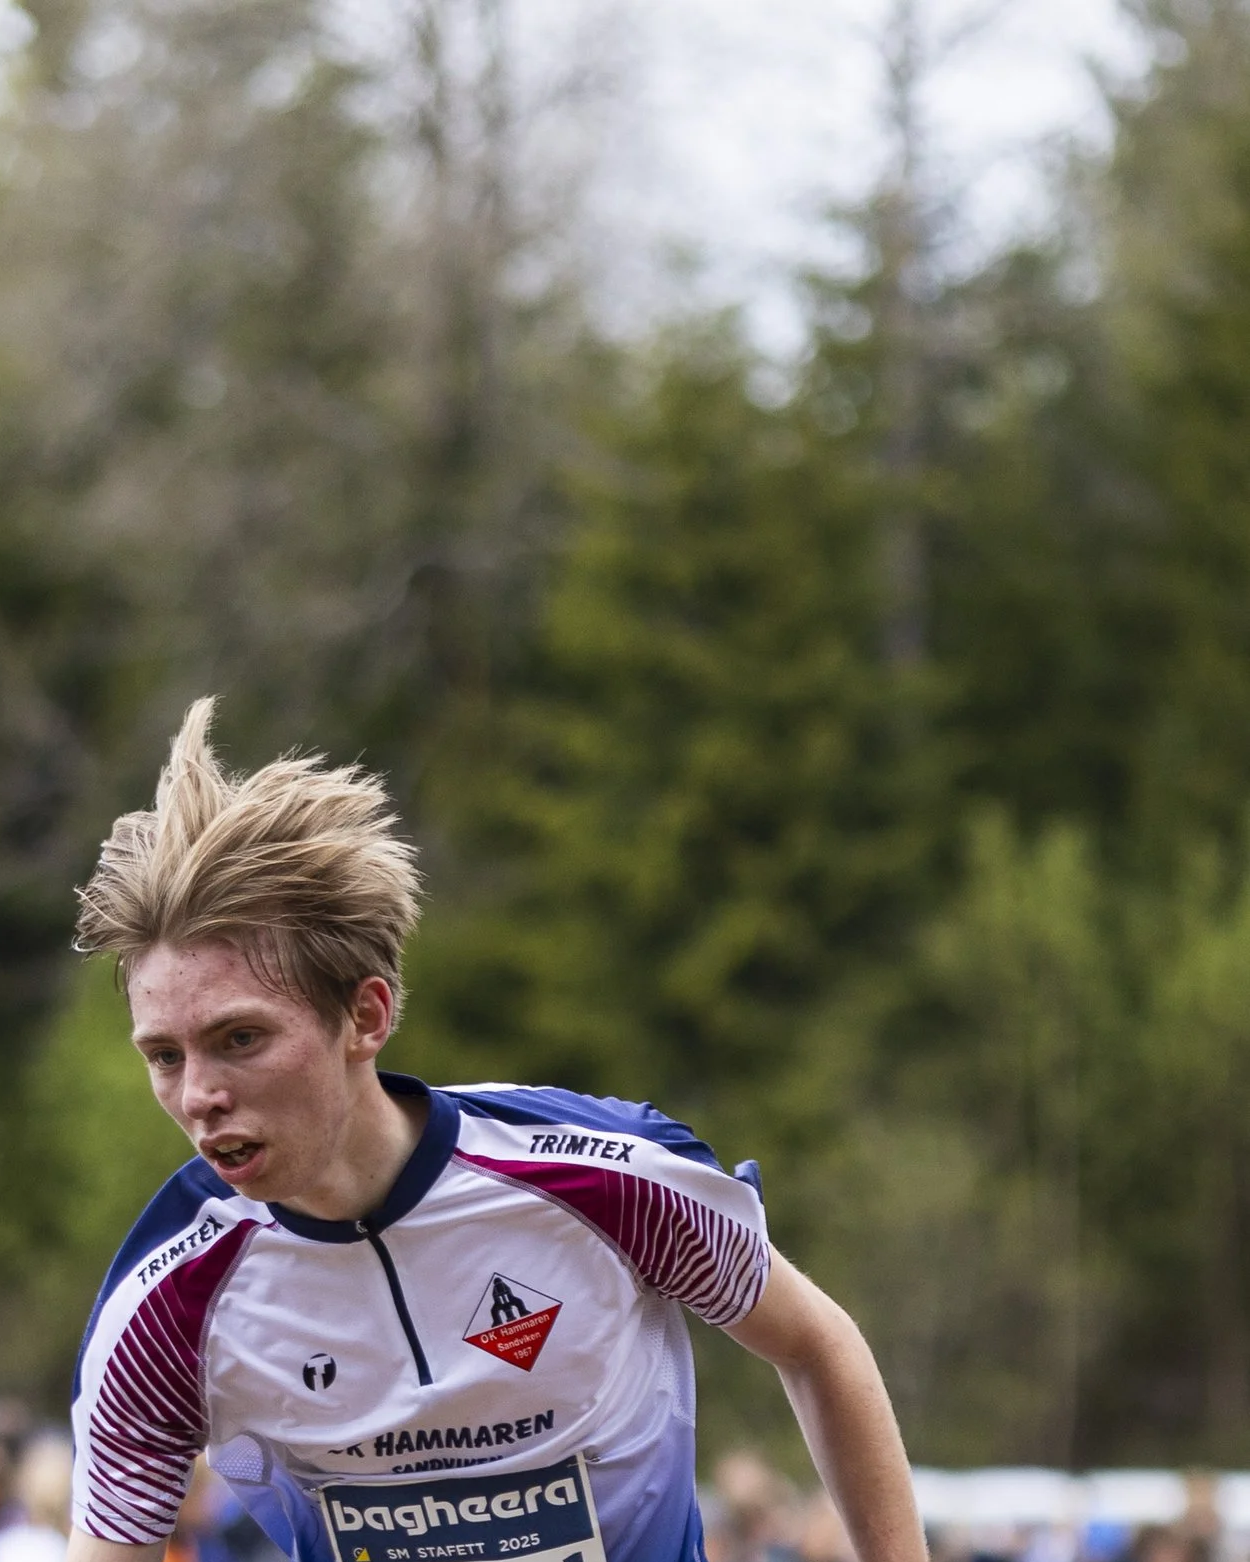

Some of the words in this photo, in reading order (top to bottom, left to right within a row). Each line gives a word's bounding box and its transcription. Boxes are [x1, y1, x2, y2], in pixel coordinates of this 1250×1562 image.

[529, 1134, 636, 1164] TRIMTEX
[137, 1214, 225, 1286] TRIMTEX
[480, 1331, 498, 1345] OK
[500, 1313, 551, 1337] Hammaren
[497, 1331, 542, 1352] Sandviken
[513, 1346, 533, 1360] 1967
[374, 1409, 555, 1458] HAMMAREN
[331, 1477, 579, 1537] bagheera
[387, 1548, 411, 1561] SM
[418, 1542, 486, 1559] STAFETT
[499, 1533, 541, 1552] 2025
